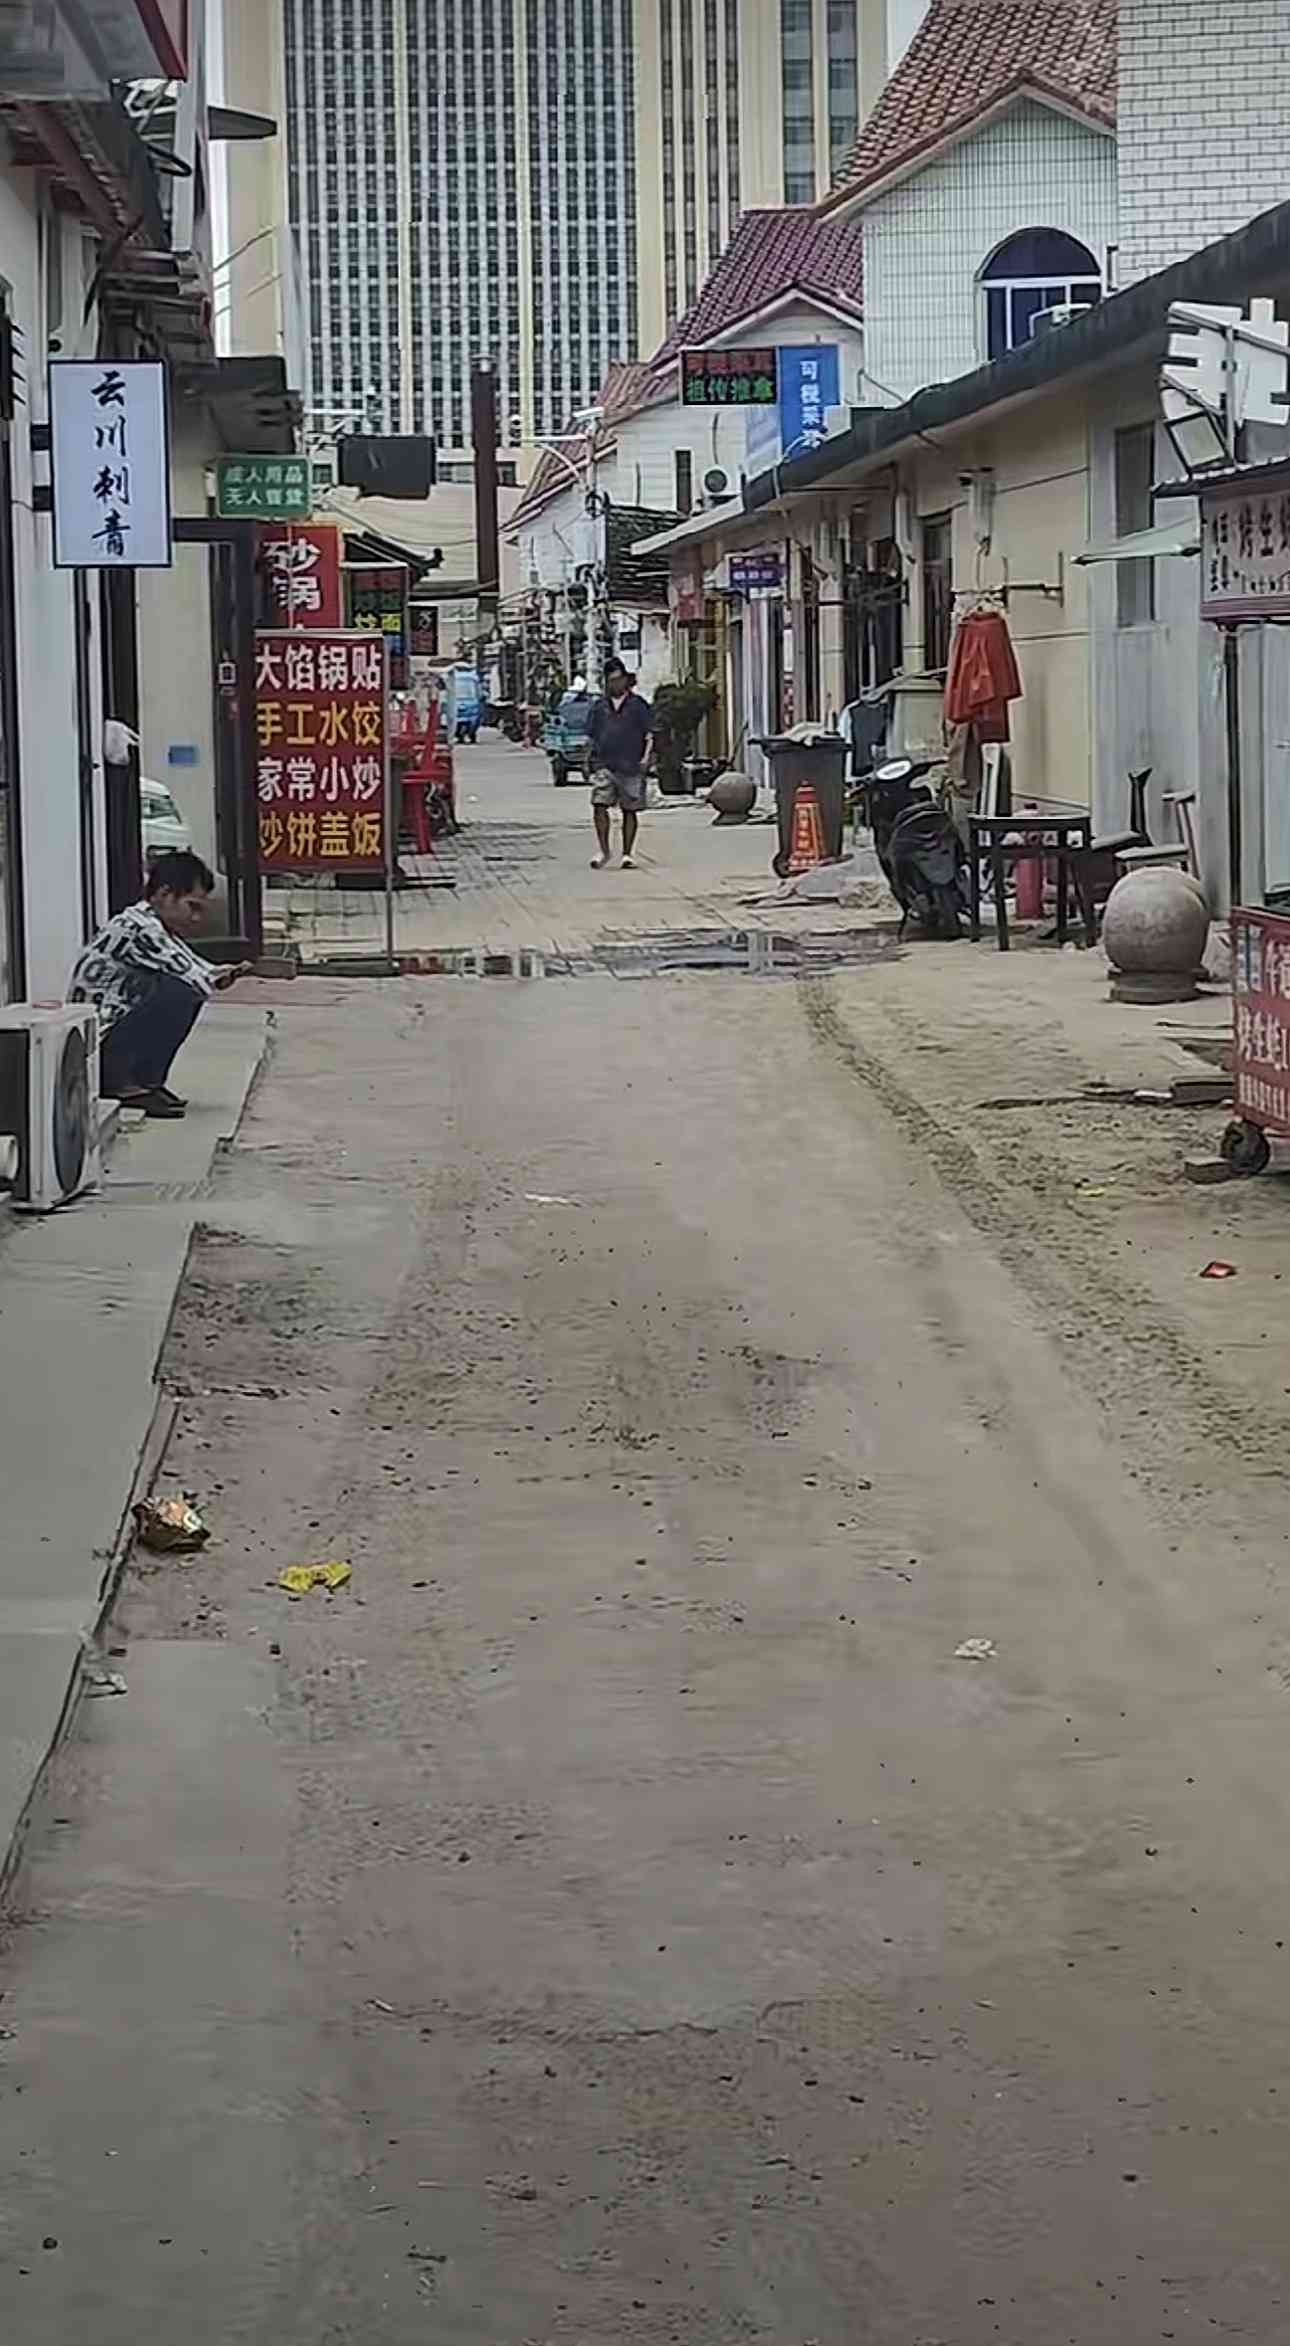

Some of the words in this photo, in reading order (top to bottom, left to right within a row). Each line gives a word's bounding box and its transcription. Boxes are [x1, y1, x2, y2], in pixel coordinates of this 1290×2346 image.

[91, 371, 130, 556] 云川刺青
[255, 644, 381, 690] 大馅锅贴
[257, 701, 381, 747] 手工水饺
[258, 756, 381, 801] 家常小炒
